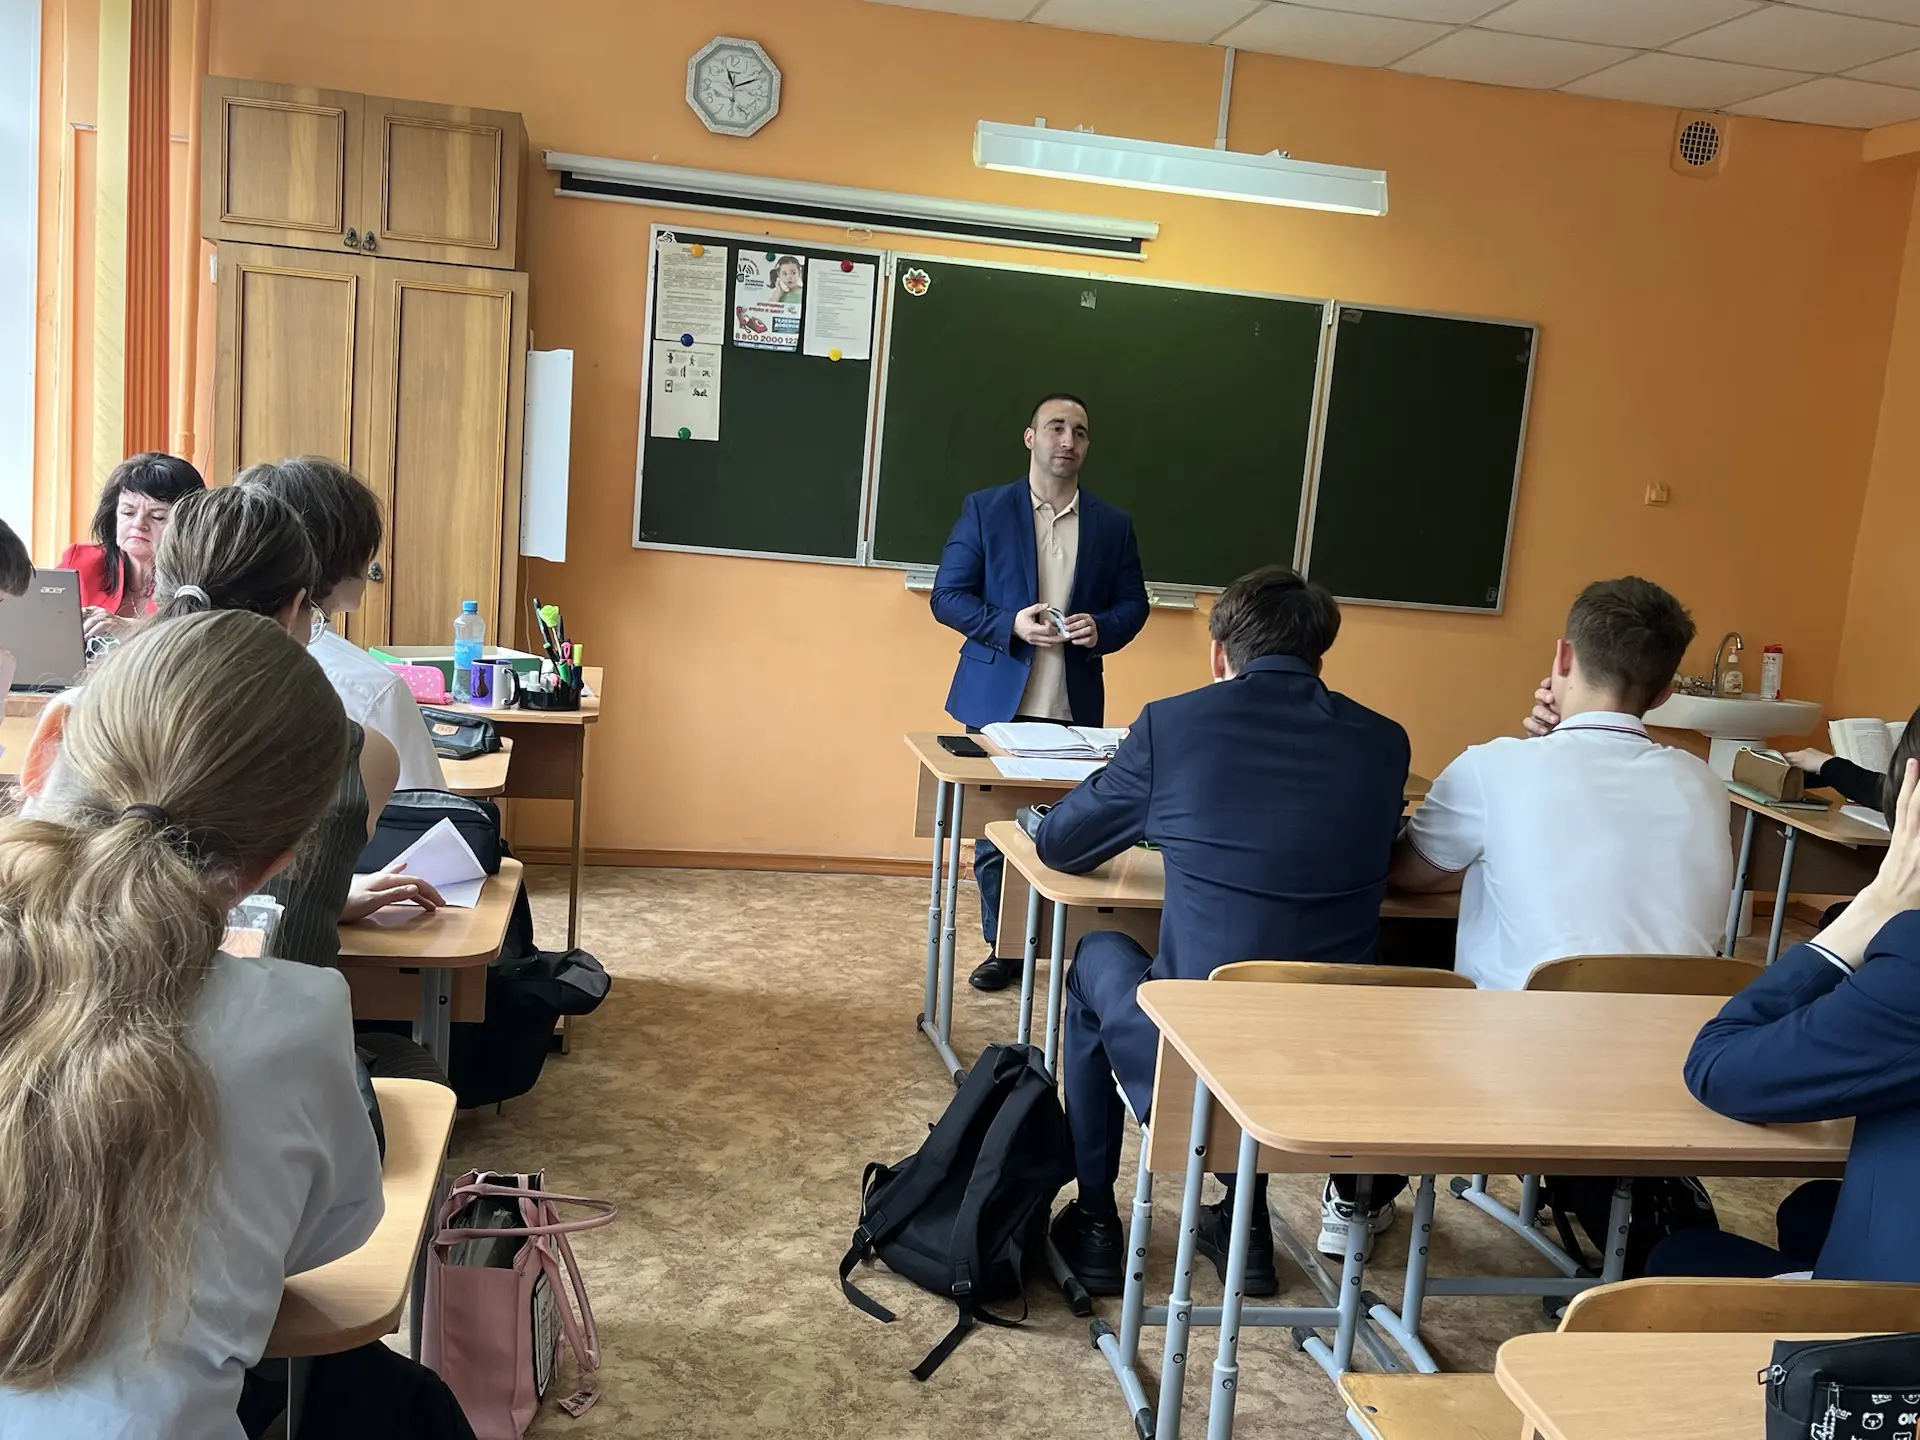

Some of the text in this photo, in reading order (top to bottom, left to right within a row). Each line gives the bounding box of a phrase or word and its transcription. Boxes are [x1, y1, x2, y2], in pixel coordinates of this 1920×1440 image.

[760, 335, 784, 343] 2000
[40, 586, 66, 594] acer
[1898, 1412, 1918, 1426] OK
